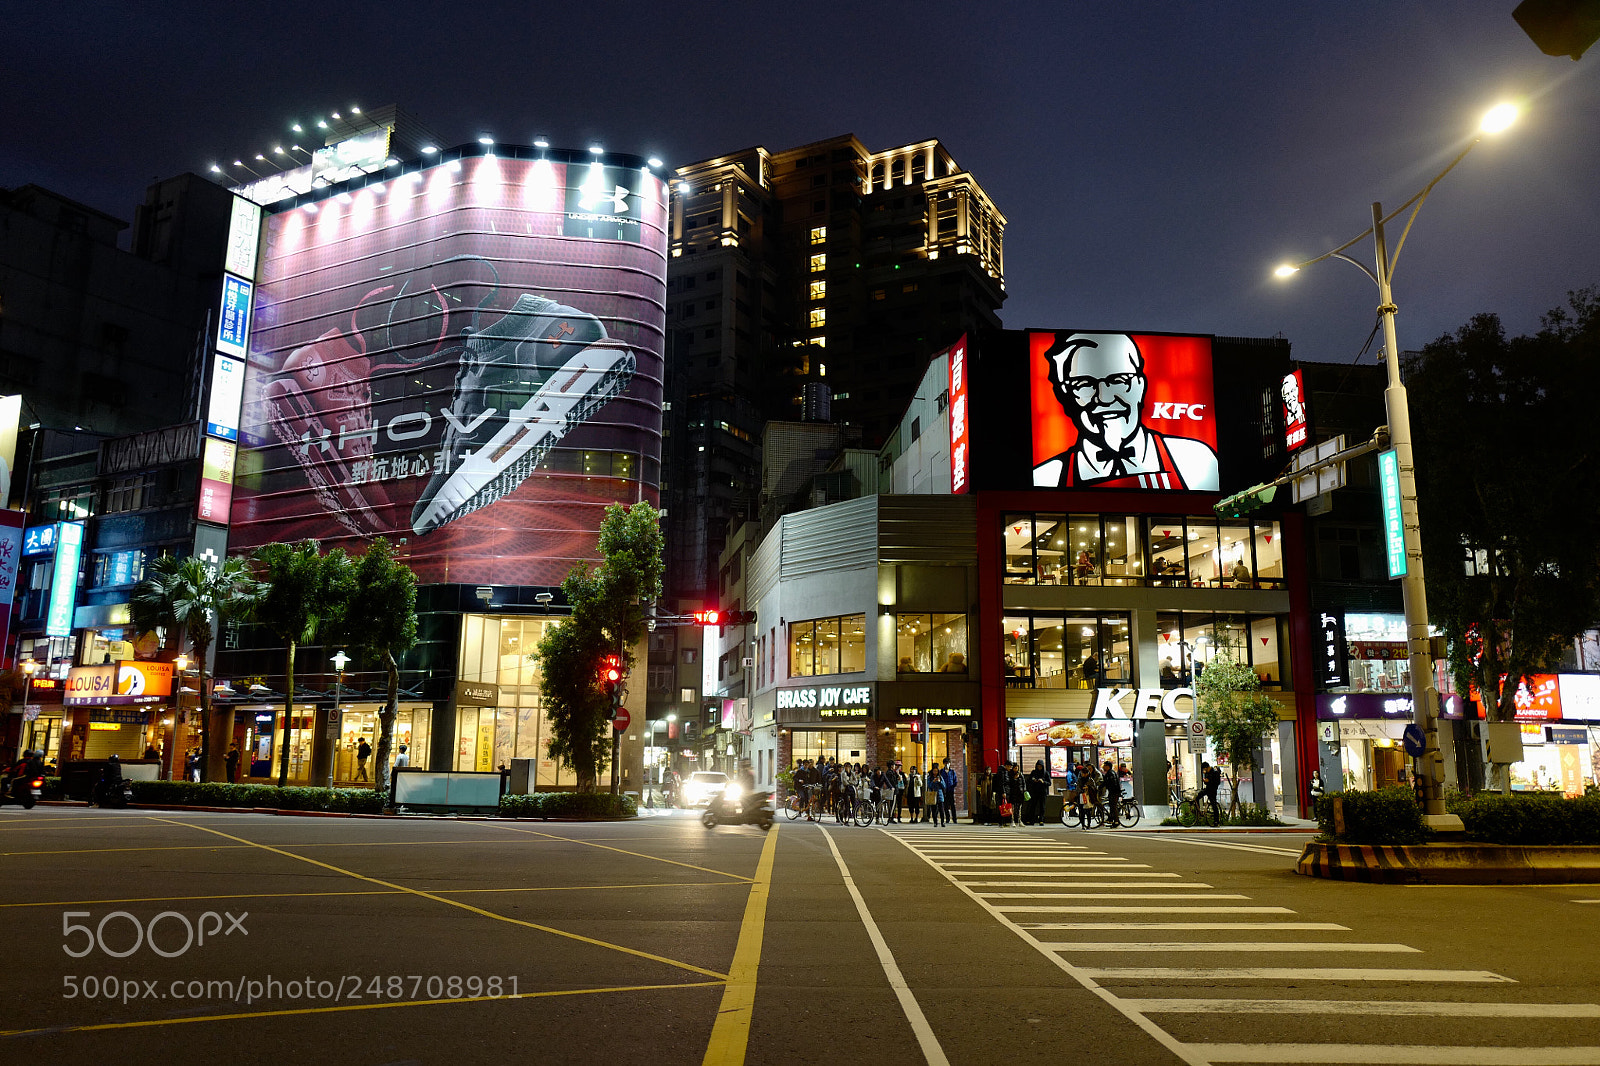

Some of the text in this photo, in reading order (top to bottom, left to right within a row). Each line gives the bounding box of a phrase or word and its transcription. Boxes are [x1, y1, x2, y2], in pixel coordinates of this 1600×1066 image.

[951, 347, 966, 493] 肯德基
[1151, 402, 1205, 421] KFC
[215, 426, 230, 436] 5F
[146, 664, 171, 672] LOUISA
[69, 675, 111, 692] LOUISA
[777, 687, 870, 709] BRASS JOY CAFE
[1091, 687, 1194, 720] KFC
